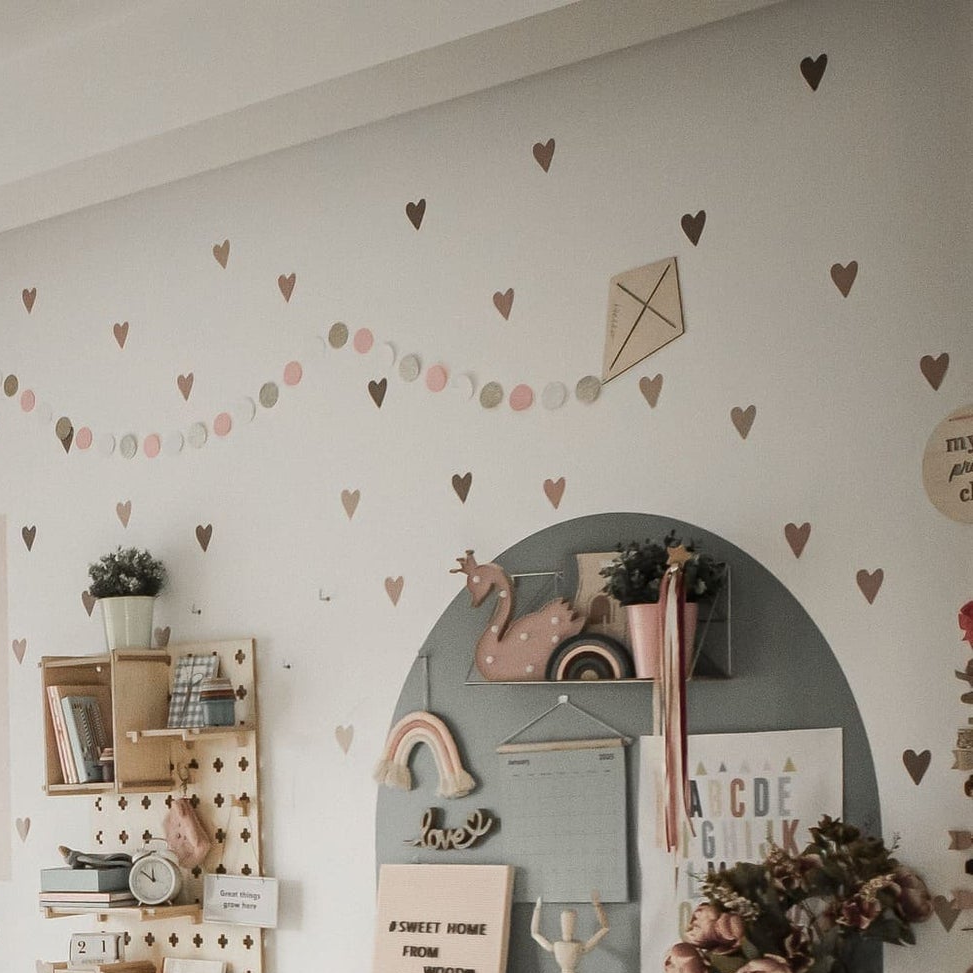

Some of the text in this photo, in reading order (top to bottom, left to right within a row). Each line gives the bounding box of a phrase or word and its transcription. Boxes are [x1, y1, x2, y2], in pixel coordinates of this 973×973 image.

[219, 889, 261, 901] Great things
[222, 901, 257, 910] grow here
[446, 922, 488, 935] HOME
[77, 939, 107, 954] 2 1
[402, 945, 440, 958] FROM
